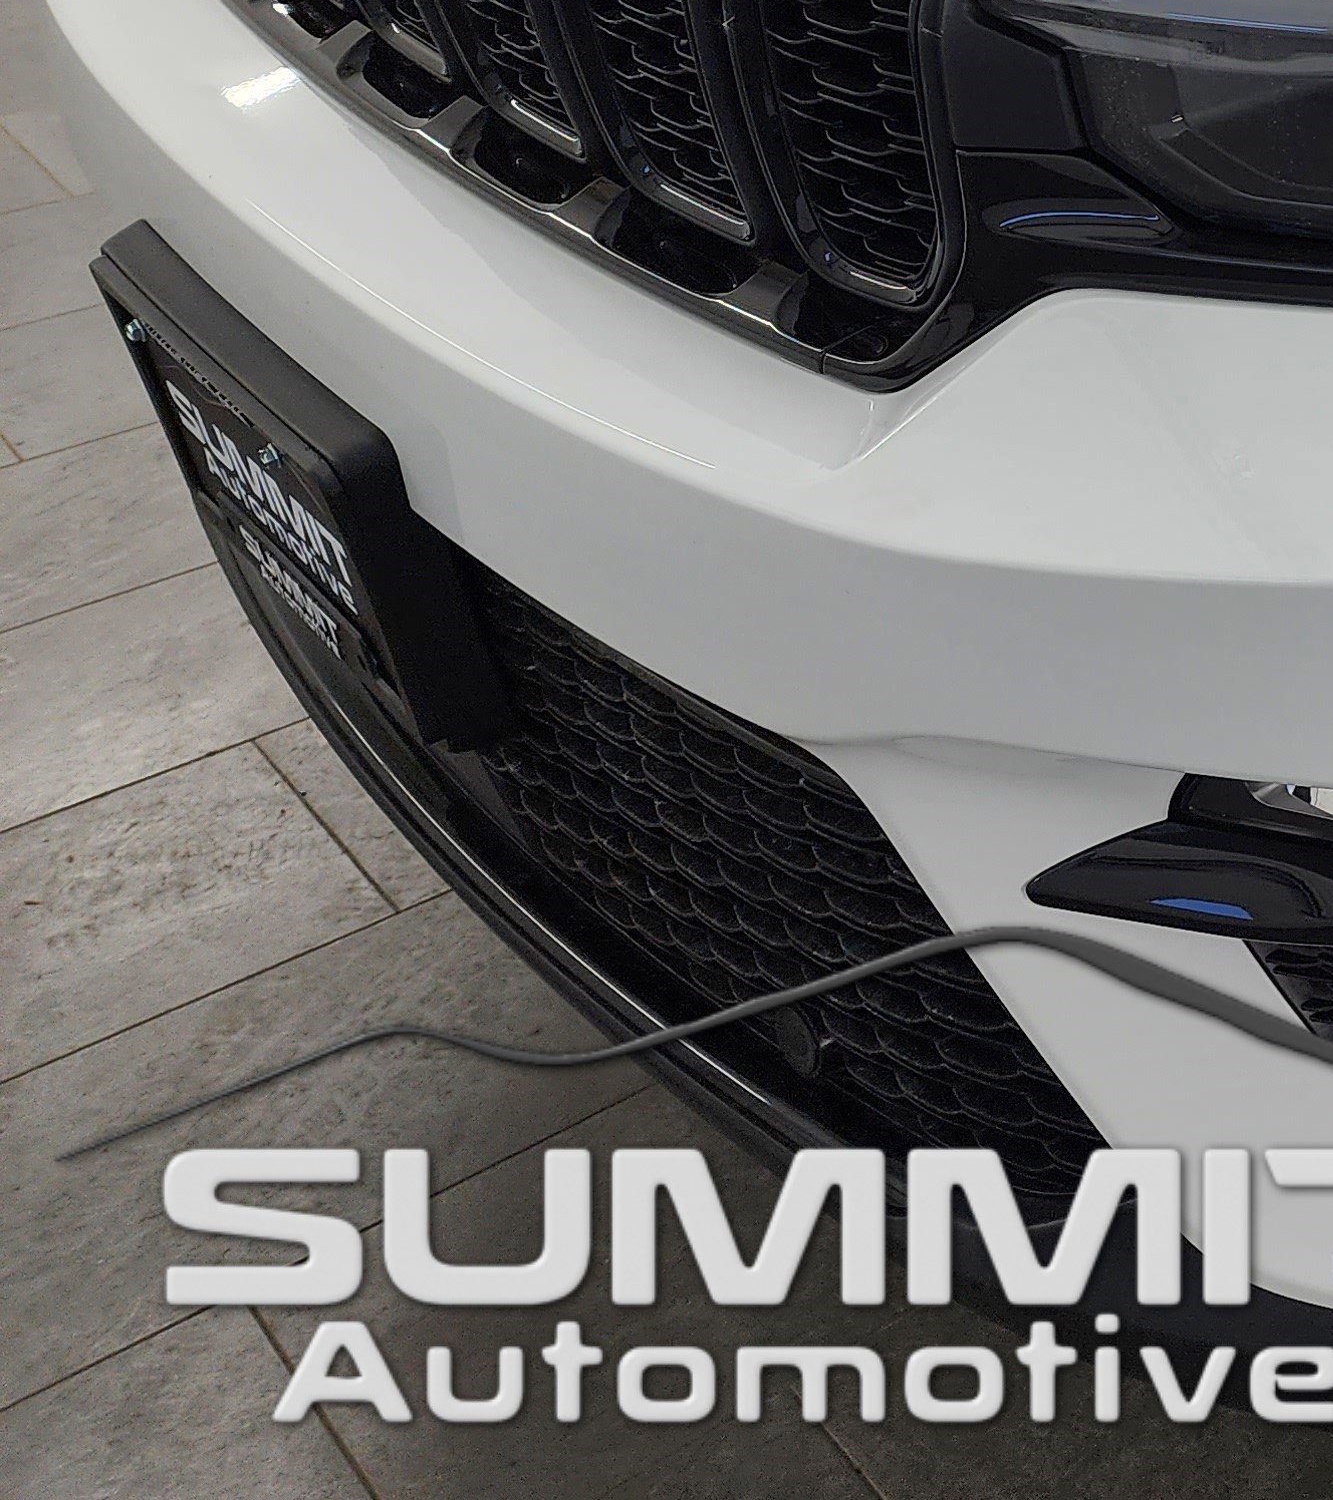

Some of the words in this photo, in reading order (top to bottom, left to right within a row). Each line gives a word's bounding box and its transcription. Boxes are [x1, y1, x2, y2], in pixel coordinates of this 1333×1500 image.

[165, 379, 352, 587] SUMMIT
[204, 447, 359, 616] Automotive
[239, 524, 338, 645] SUMMIT
